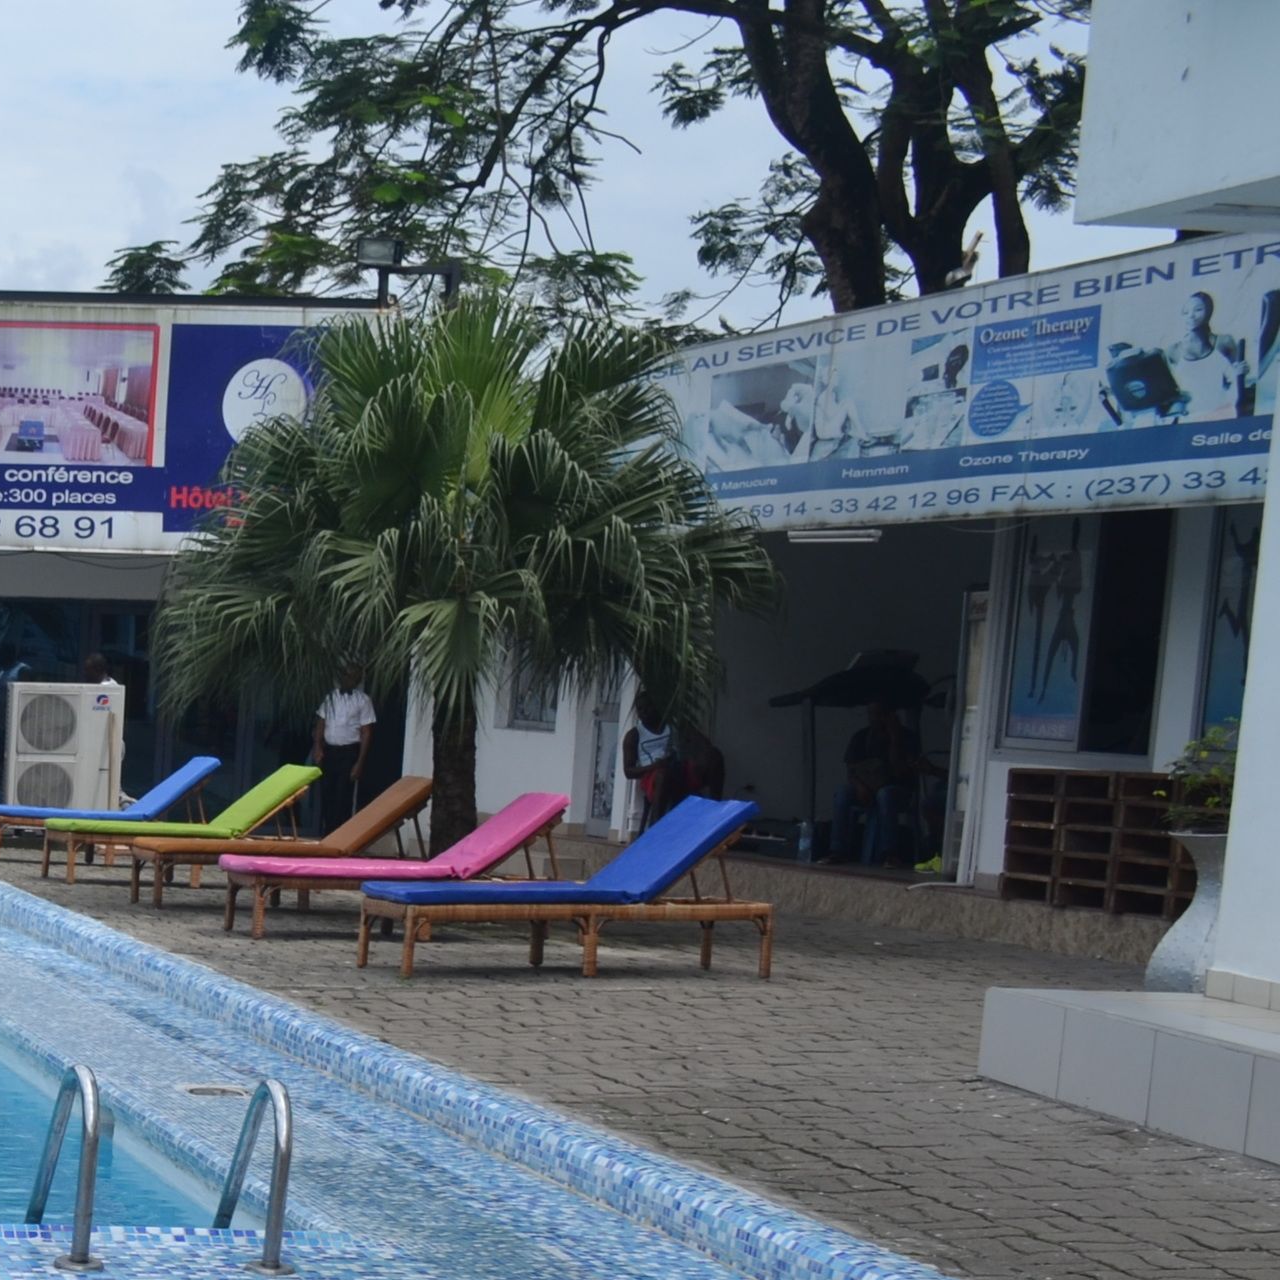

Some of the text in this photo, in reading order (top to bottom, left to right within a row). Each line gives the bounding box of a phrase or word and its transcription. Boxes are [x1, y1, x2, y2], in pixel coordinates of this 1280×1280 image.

[692, 351, 729, 371] AU
[737, 325, 865, 361] SERVICE
[877, 314, 920, 336] DE
[932, 285, 1060, 323] VOTRE
[1074, 262, 1174, 299] BIEN
[980, 317, 1093, 343] Ozone Therapy
[1192, 433, 1242, 446] Salle
[959, 449, 1089, 466] Ozone Therapy
[5, 467, 133, 484] conférence
[842, 466, 909, 478] Hammam
[721, 478, 777, 490] Manucure
[52, 490, 116, 506] places
[784, 502, 807, 516] 14
[830, 499, 858, 513] 33
[866, 496, 897, 511] 42
[909, 492, 937, 508] 12
[947, 488, 979, 505] 96
[991, 483, 1054, 501] FAX
[1085, 474, 1170, 501] (237)
[1183, 471, 1226, 489] 33
[15, 516, 59, 538] 68
[75, 517, 112, 539] 91
